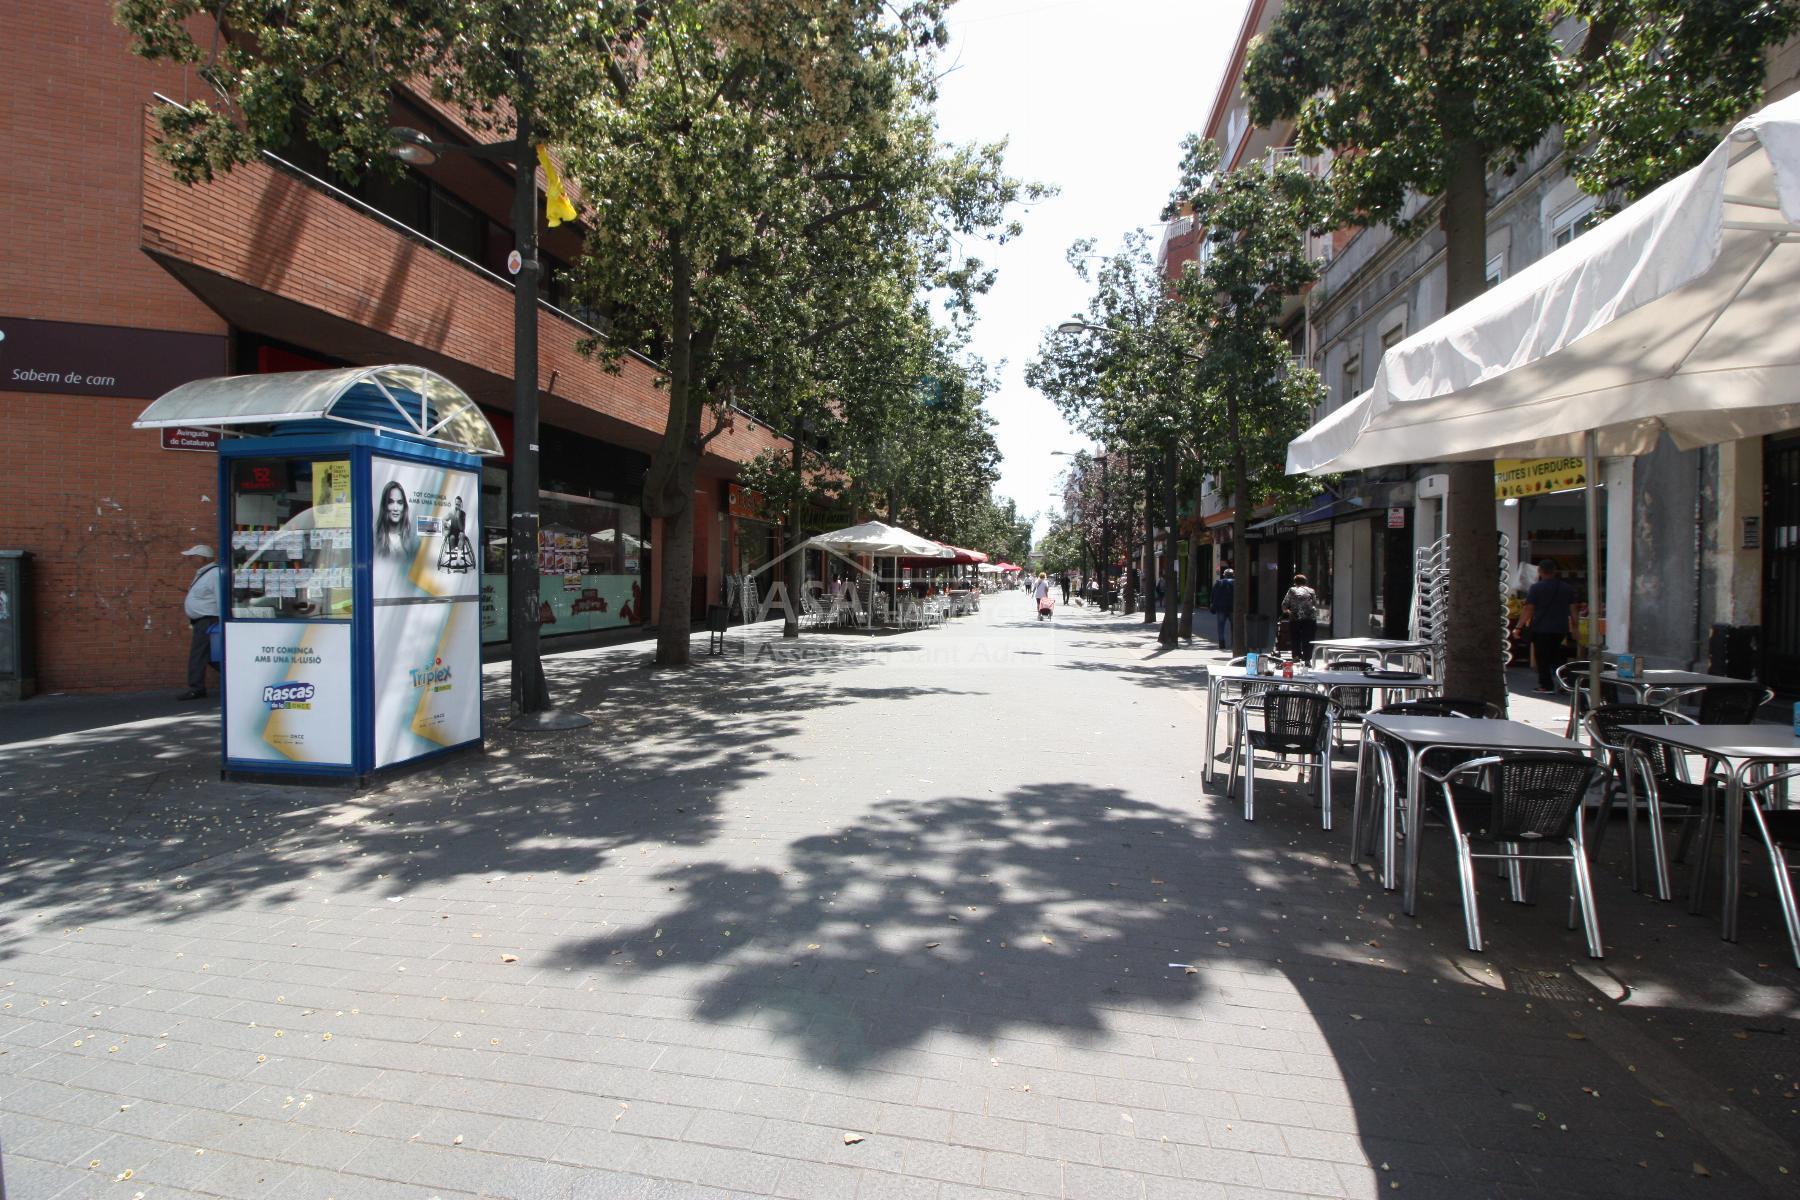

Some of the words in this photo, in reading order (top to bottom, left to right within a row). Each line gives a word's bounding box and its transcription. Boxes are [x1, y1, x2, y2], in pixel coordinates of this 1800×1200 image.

[11, 368, 60, 383] Sabem
[64, 371, 82, 384] de
[86, 376, 115, 386] carn
[176, 428, 209, 438] Avinguda
[181, 438, 215, 447] Catalunya
[1532, 457, 1583, 476] VERDURES
[262, 646, 275, 654] TOT
[254, 655, 271, 663] AMB
[273, 656, 289, 664] UNA
[409, 665, 452, 688] Triplex
[263, 685, 314, 702] Rascas
